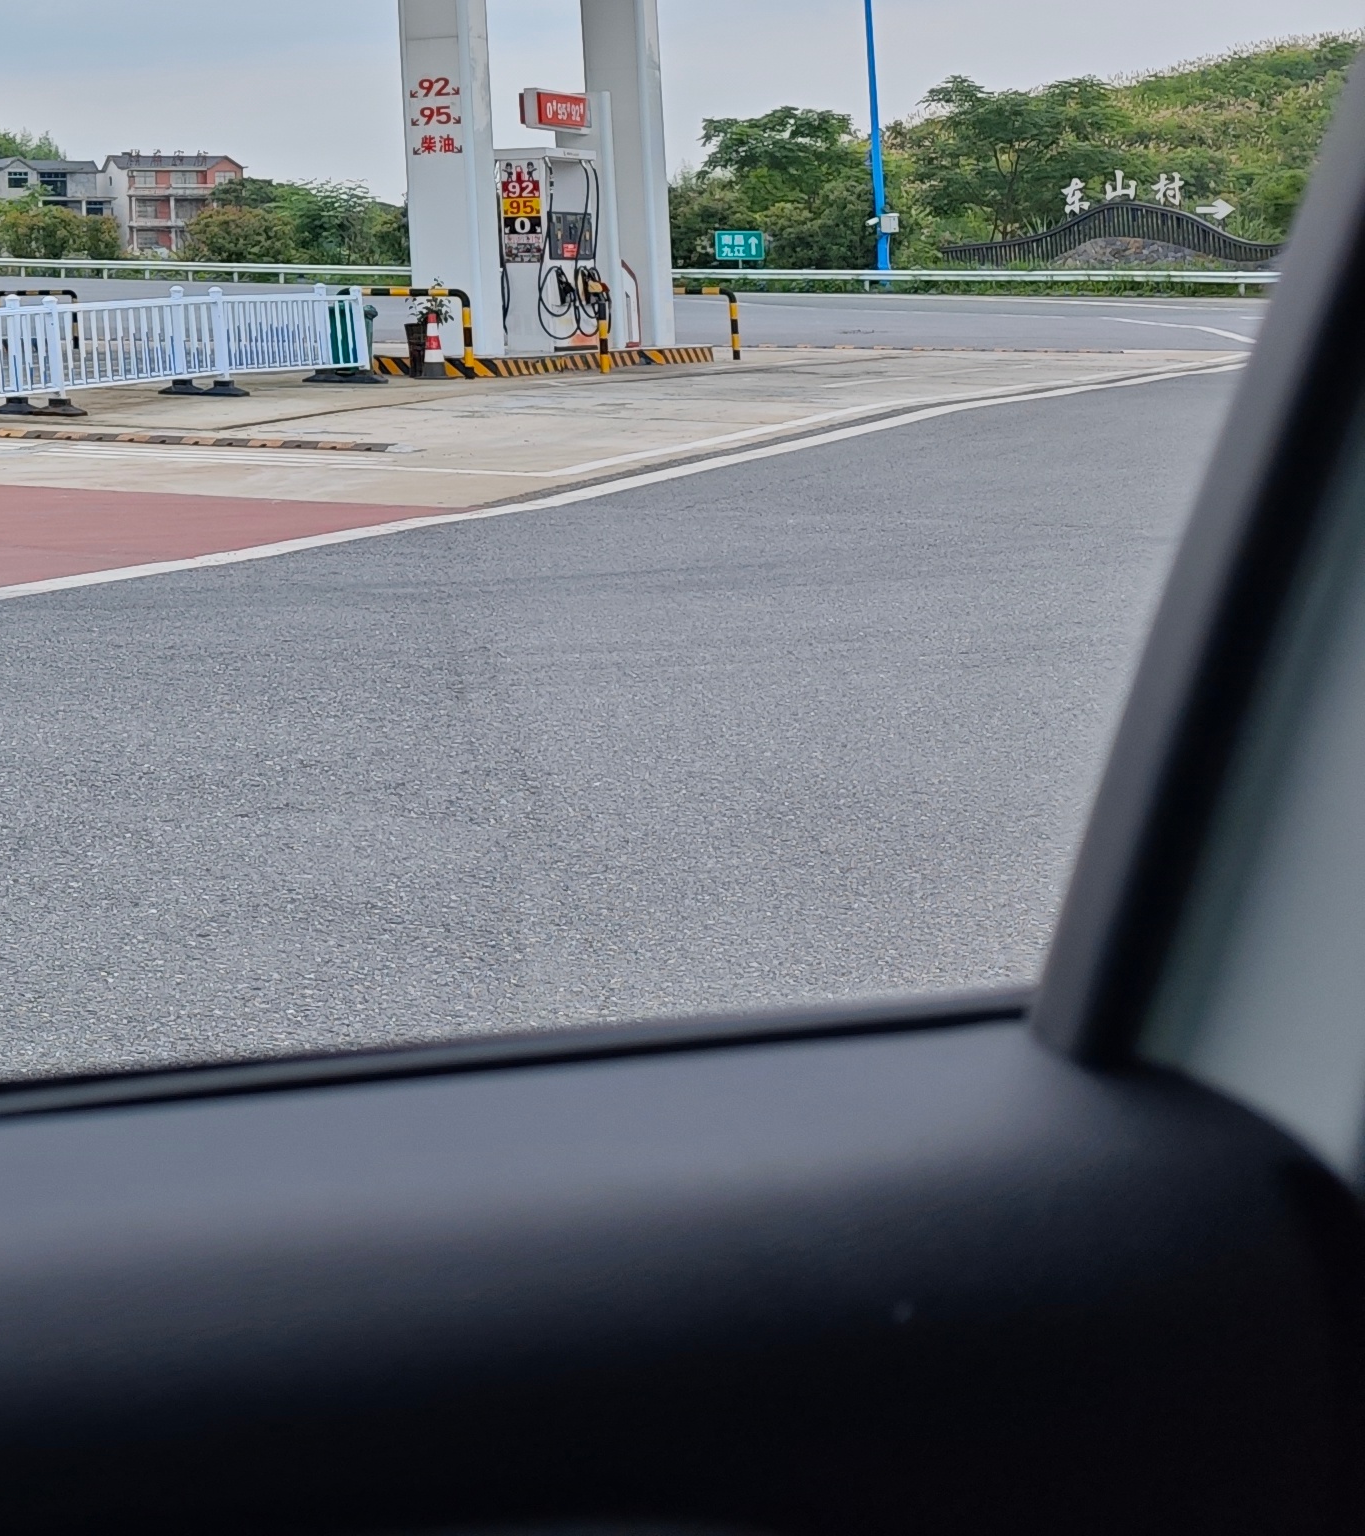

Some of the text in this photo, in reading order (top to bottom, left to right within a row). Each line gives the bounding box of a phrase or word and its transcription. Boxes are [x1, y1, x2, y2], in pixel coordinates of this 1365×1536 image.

[418, 77, 451, 98] 92
[419, 105, 452, 126] 95
[420, 134, 455, 155] 柴油
[507, 181, 534, 197] 92
[1061, 169, 1184, 214] 东山村
[509, 199, 535, 215] 95
[514, 217, 531, 234] 0
[721, 246, 746, 256] 九江
